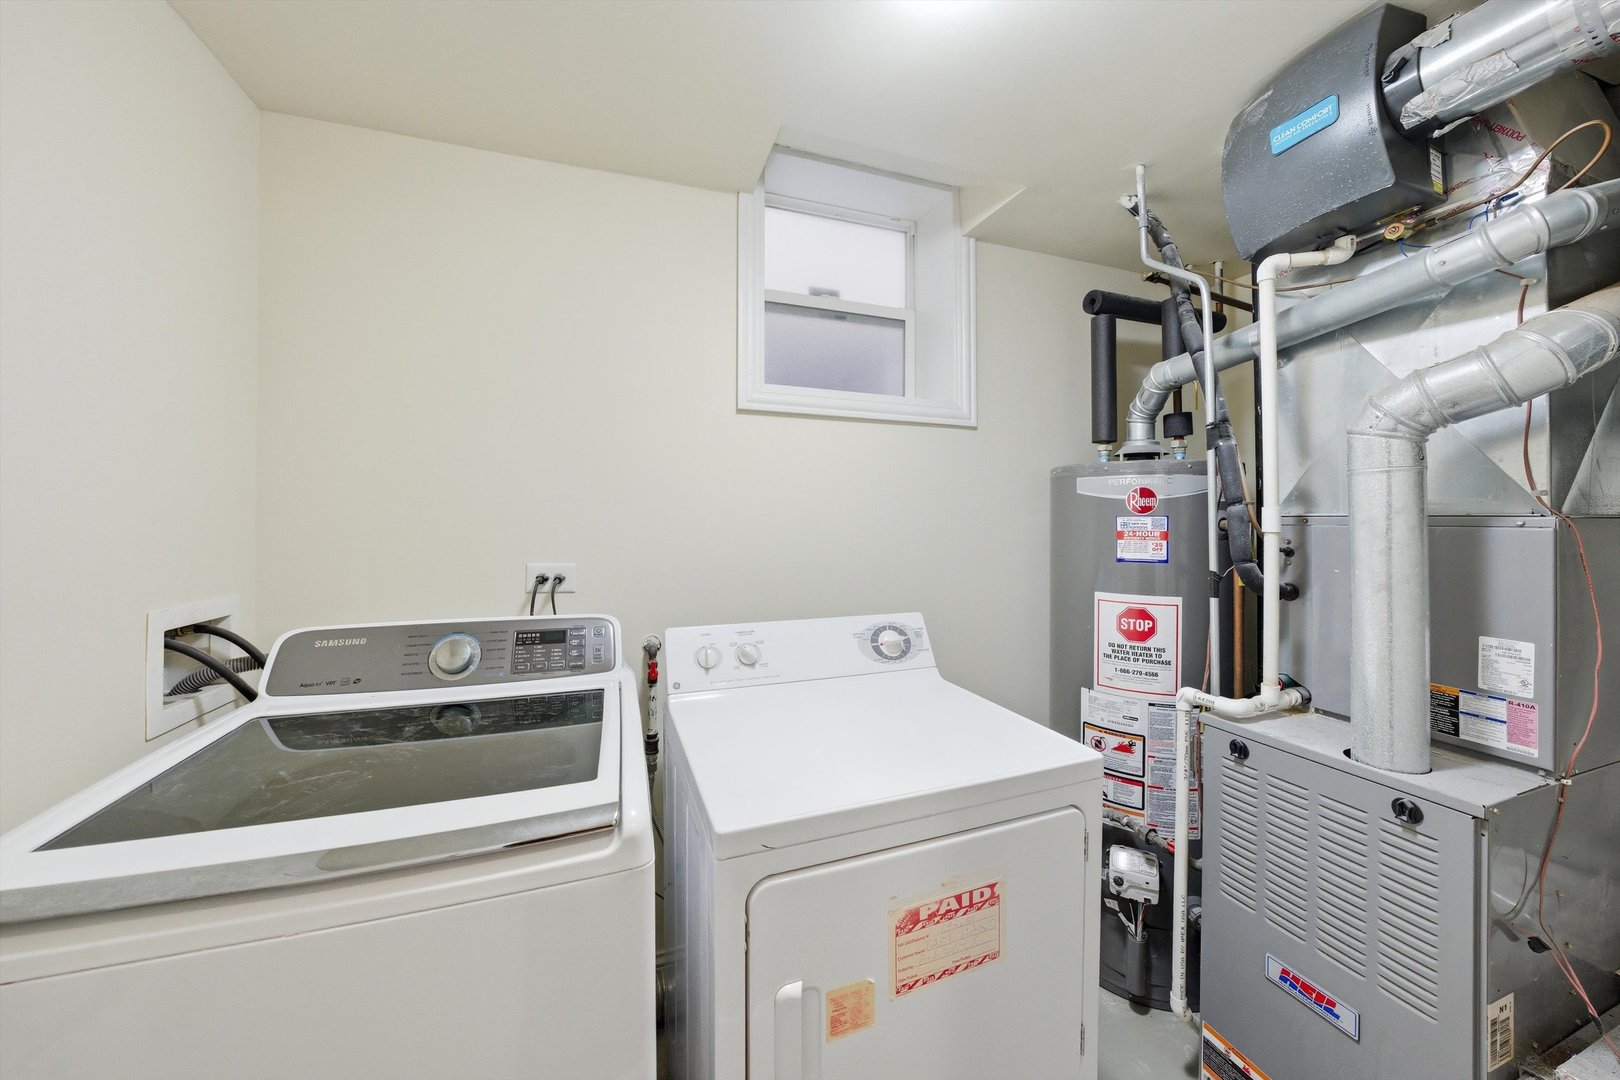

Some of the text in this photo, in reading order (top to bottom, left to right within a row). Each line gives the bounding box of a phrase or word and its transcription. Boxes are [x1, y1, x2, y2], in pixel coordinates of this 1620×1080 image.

[1273, 104, 1334, 143] CLEAN COMFORT
[1130, 487, 1157, 511] Rheem
[1120, 618, 1153, 633] STOP
[314, 637, 368, 648] SAMSUNG
[1129, 644, 1152, 652] RETURN
[1153, 646, 1166, 654] THIS
[1103, 652, 1113, 660] THE
[1114, 654, 1131, 663] PLACE
[1141, 657, 1172, 667] PURCHASE
[1111, 648, 1130, 656] WATER
[1131, 650, 1153, 659] HEATER
[1508, 700, 1537, 711] R-410A
[919, 886, 992, 921] PAID
[1279, 966, 1341, 1021] HEIL
